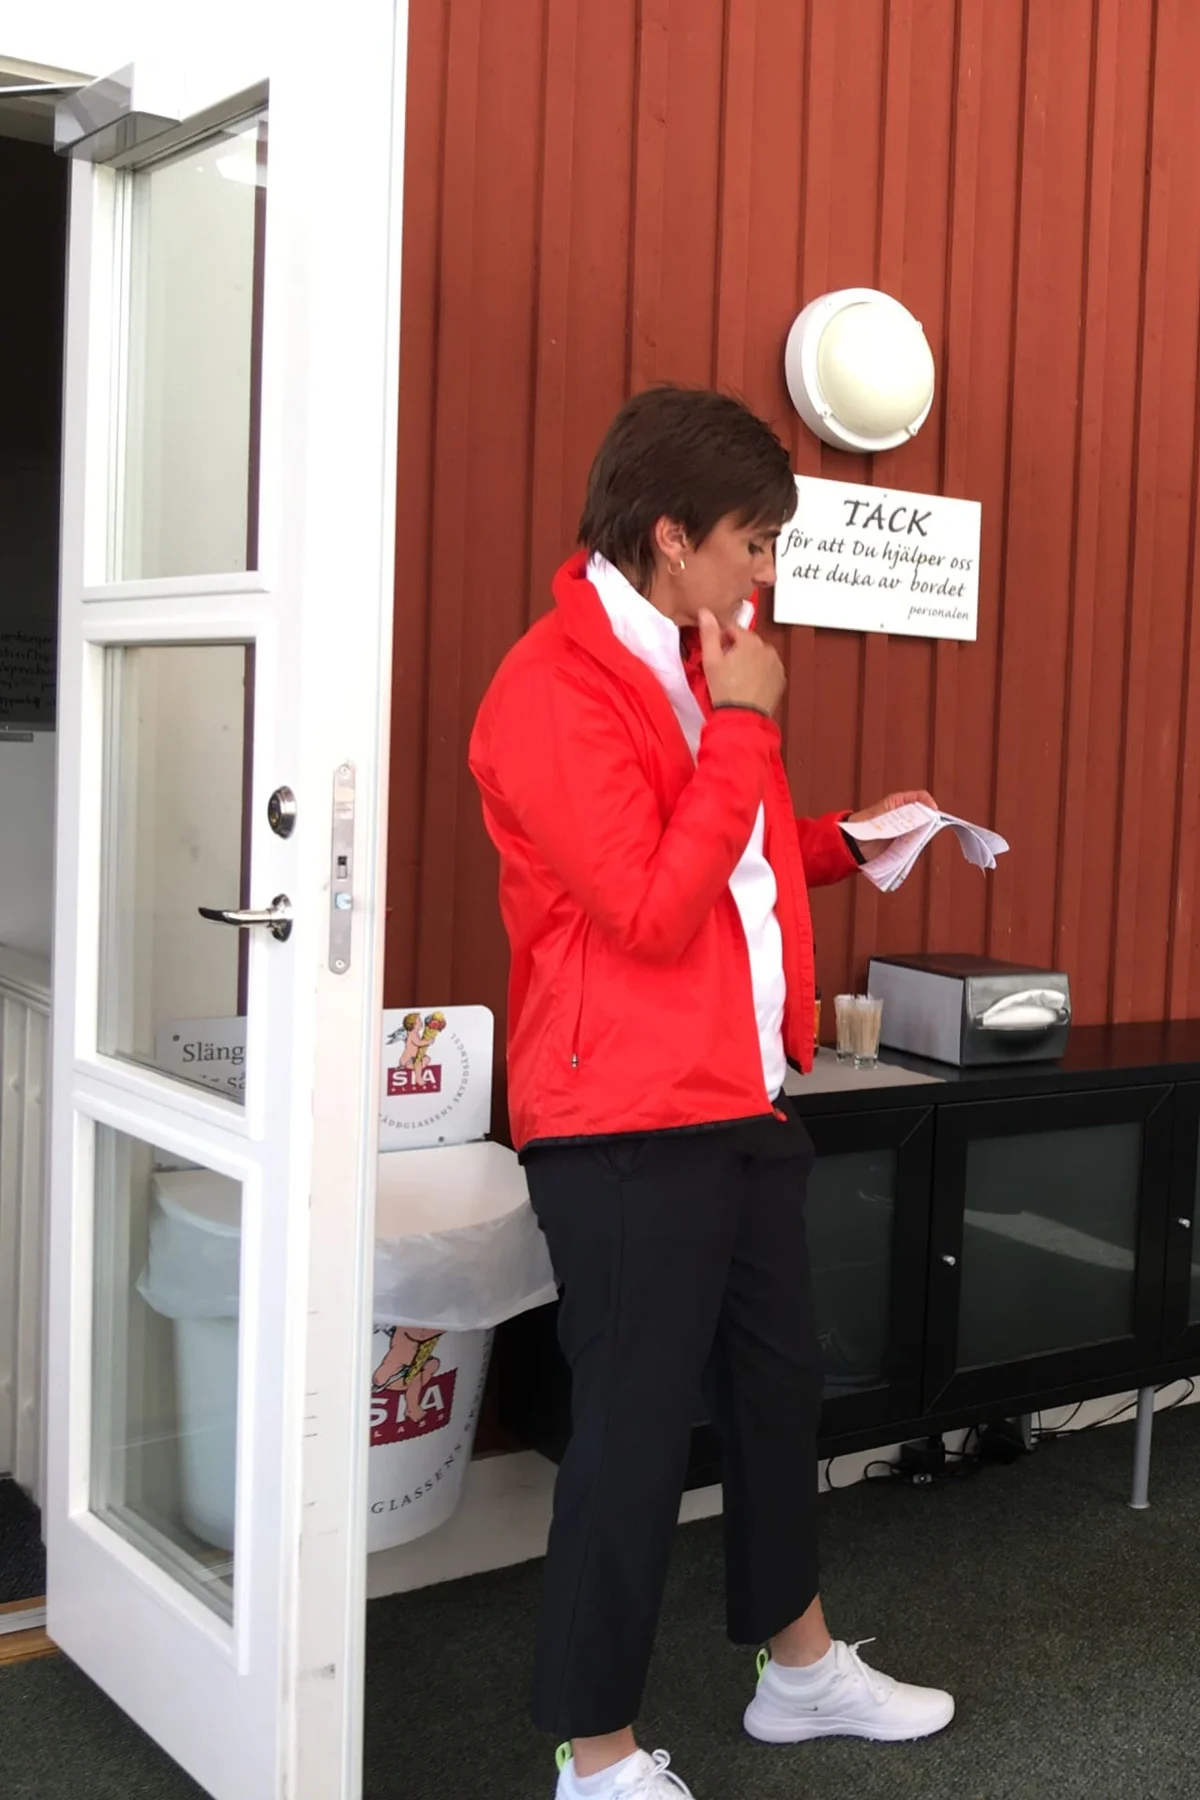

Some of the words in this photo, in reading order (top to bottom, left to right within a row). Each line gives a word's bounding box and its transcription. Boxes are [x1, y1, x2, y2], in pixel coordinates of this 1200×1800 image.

[843, 500, 932, 537] TACK
[781, 528, 813, 557] för
[817, 537, 845, 554] att
[852, 540, 879, 559] Du
[882, 541, 946, 572] hjälper
[950, 557, 973, 571] oss
[792, 563, 821, 580] att
[826, 563, 874, 587] duka
[878, 578, 901, 589] av
[910, 569, 965, 597] bordet
[907, 604, 970, 621] personalen
[182, 1041, 245, 1066] Släng
